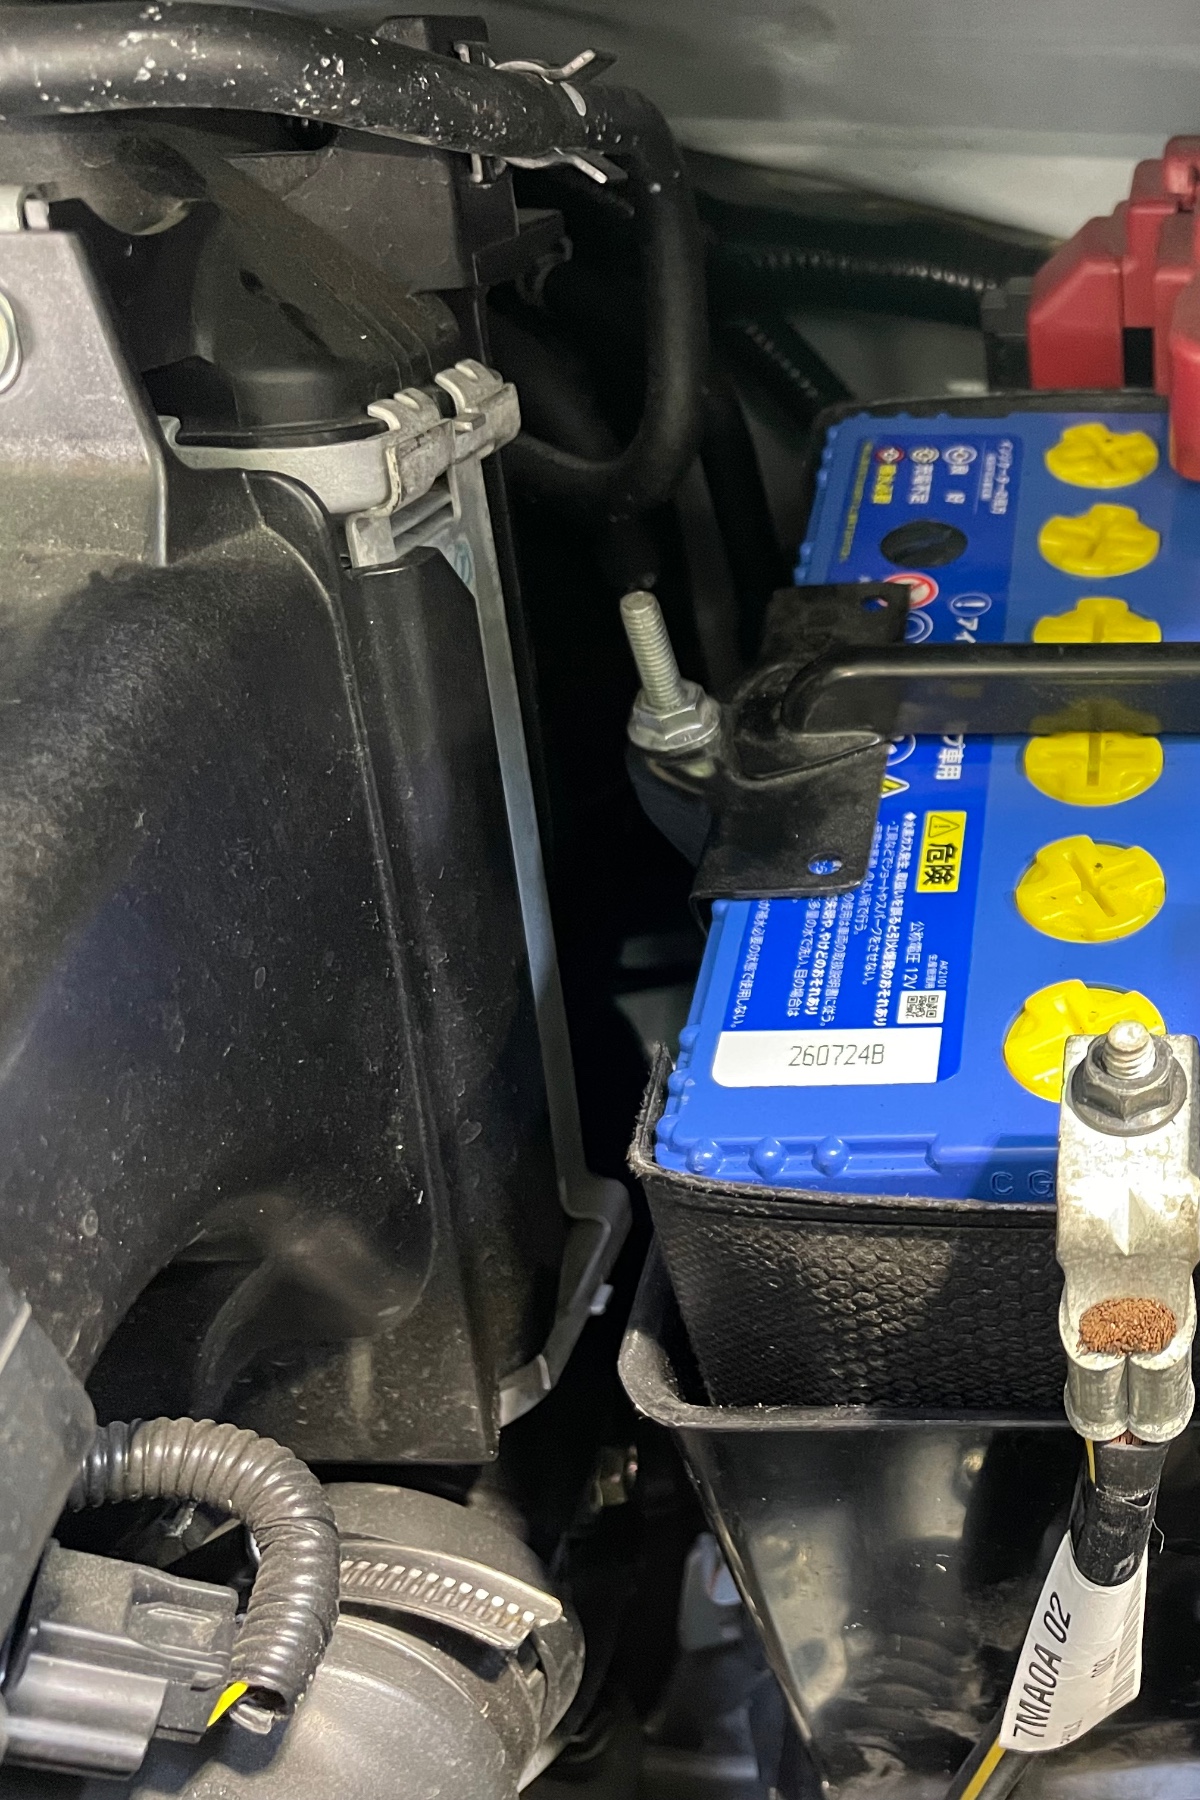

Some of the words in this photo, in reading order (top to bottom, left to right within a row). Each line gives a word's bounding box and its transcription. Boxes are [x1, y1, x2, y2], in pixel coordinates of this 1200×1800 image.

[922, 842, 956, 887] 危険
[905, 921, 925, 963] 公称電圧
[730, 899, 771, 1028] が補水必要の状態で使用しない。
[902, 967, 919, 989] 12V
[937, 960, 949, 988] AK2101
[788, 1042, 886, 1068] 260724B
